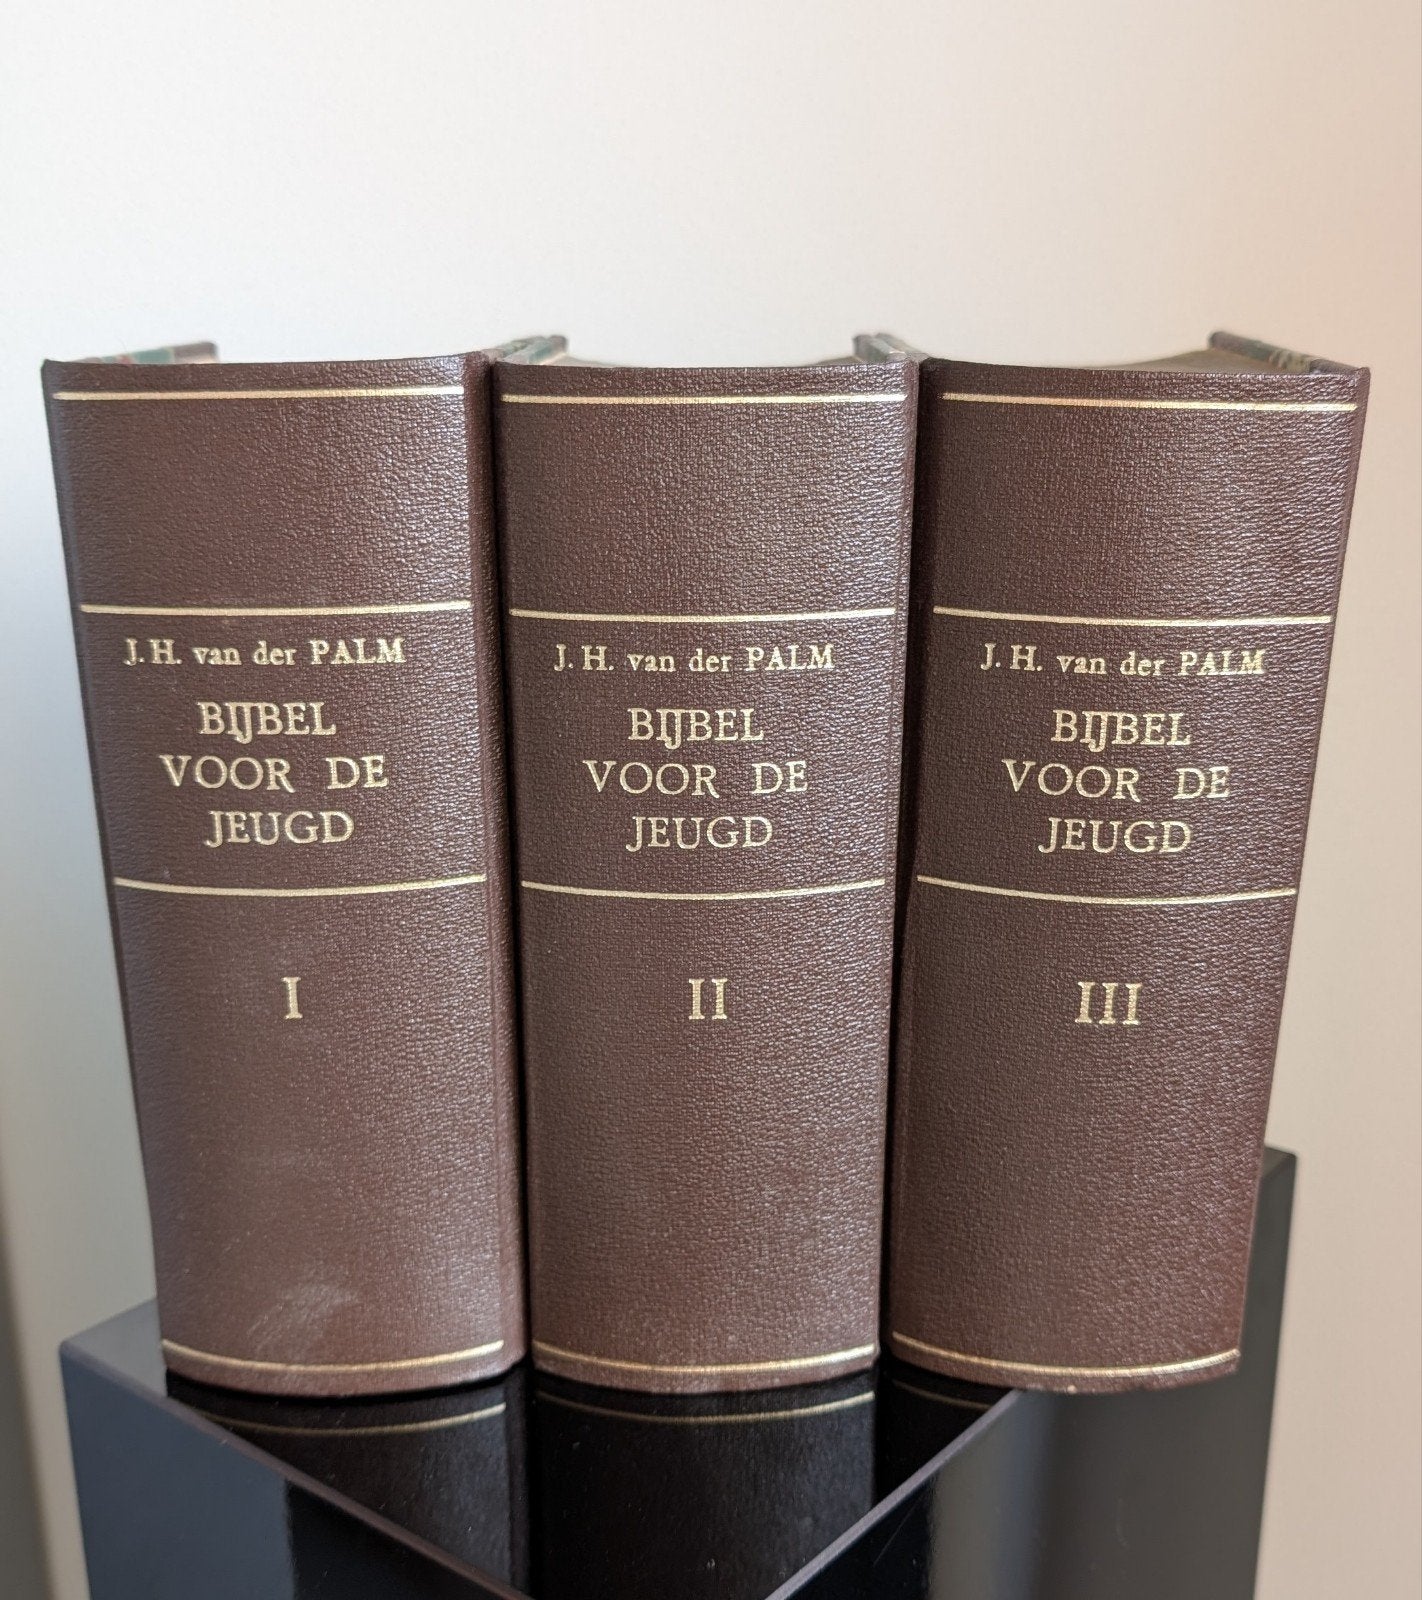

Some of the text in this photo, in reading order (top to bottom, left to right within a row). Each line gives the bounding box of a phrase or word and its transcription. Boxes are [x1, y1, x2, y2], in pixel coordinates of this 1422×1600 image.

[193, 647, 241, 666] van
[253, 641, 296, 666] der
[309, 638, 406, 665] PALM
[554, 644, 835, 673] J. H. van der PALM
[980, 643, 1266, 676] J. H. van der PALM
[197, 701, 336, 744] BIJBEL
[628, 708, 764, 749] BIJBEL
[1051, 709, 1191, 753] BIJBEL
[159, 754, 389, 793] VOOR DE
[583, 760, 809, 799] VOOR DE
[1001, 759, 1230, 802] VOOR DE
[204, 811, 355, 847] JEUGD
[626, 816, 773, 852] JEUGD
[1038, 817, 1191, 854] JEUGD
[281, 976, 303, 1019] I
[688, 977, 728, 1020] II
[1075, 981, 1144, 1026] III
